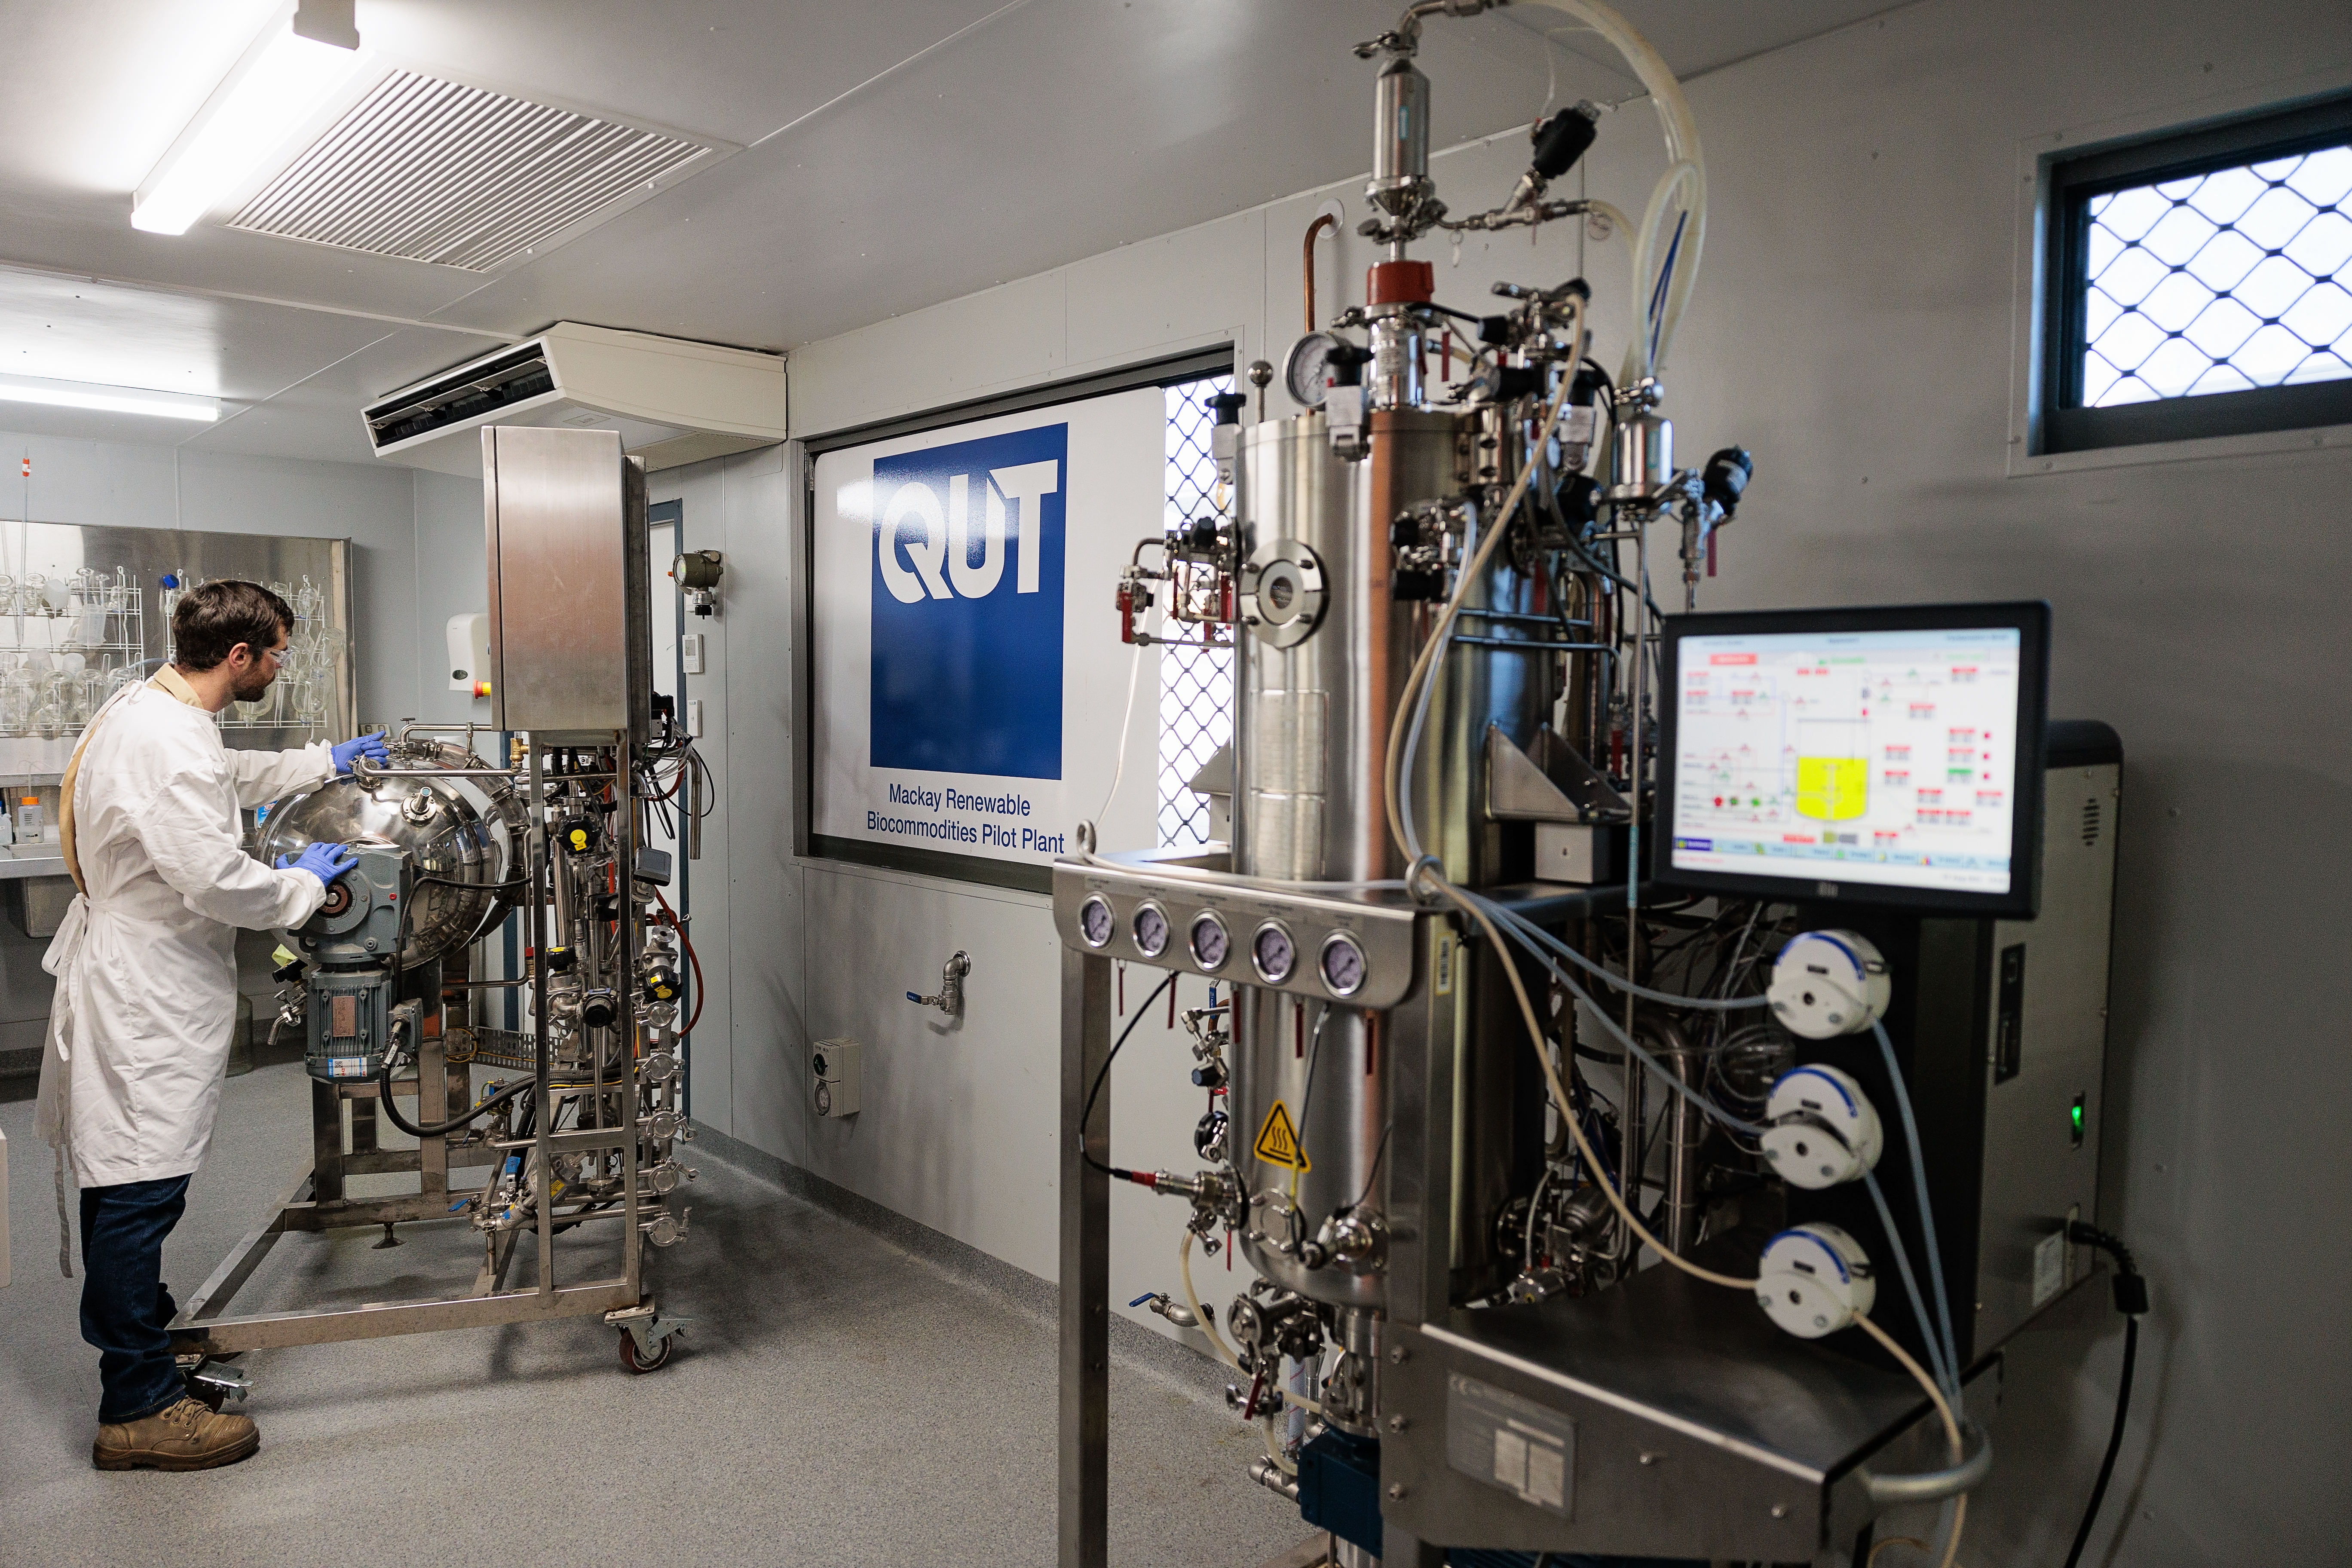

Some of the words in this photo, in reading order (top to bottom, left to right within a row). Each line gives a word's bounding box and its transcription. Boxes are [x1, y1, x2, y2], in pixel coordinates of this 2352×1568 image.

[879, 459, 1058, 603] QUT
[890, 784, 941, 812] Mackay
[946, 788, 1030, 816] Renewable
[867, 811, 977, 843] Biocommodities
[983, 824, 1017, 848] Pilot
[1023, 828, 1064, 854] Plant
